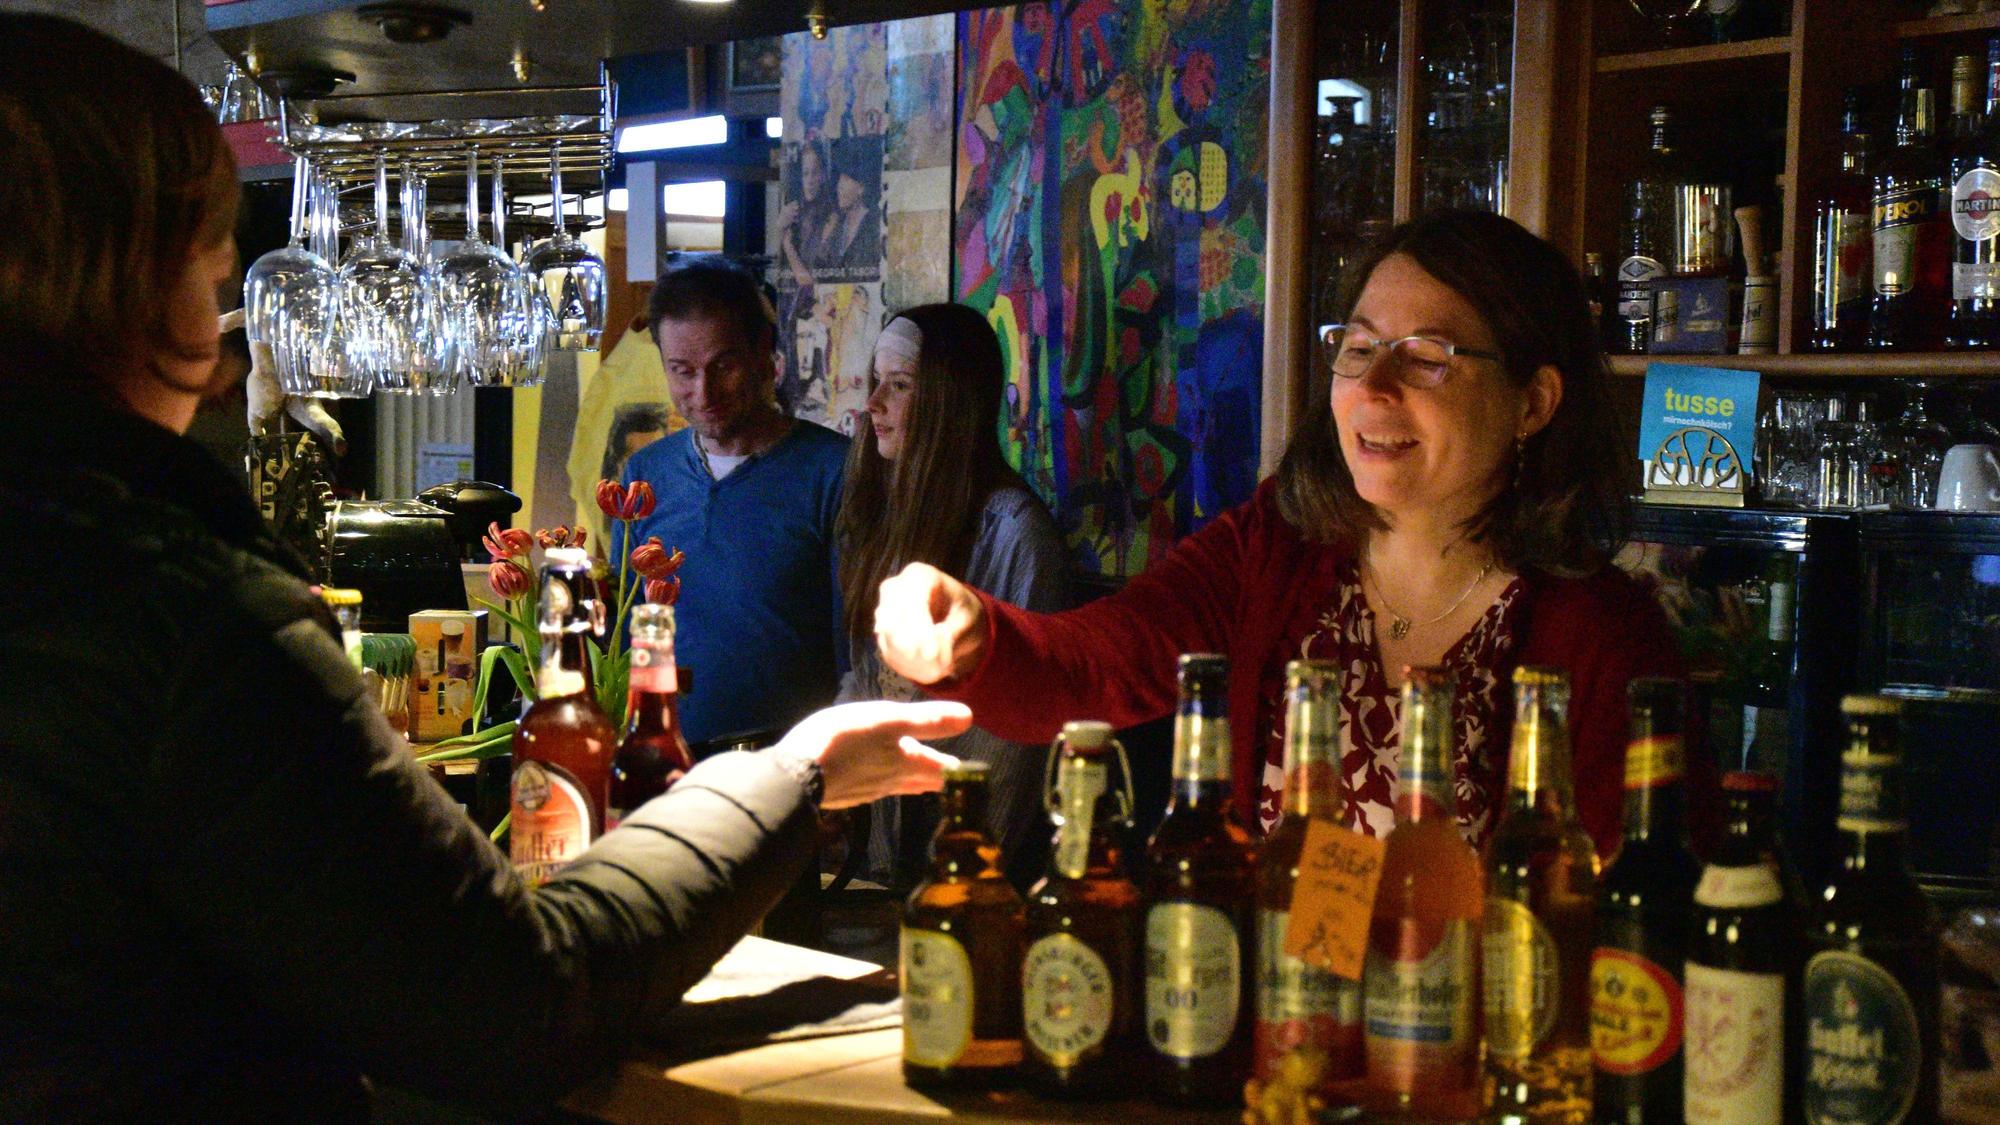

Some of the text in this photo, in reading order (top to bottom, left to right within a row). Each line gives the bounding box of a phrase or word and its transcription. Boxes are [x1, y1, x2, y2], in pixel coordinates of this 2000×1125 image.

[1873, 200, 1926, 224] PEROL
[1956, 199, 2000, 213] MARTIN
[1665, 387, 1735, 417] tusse
